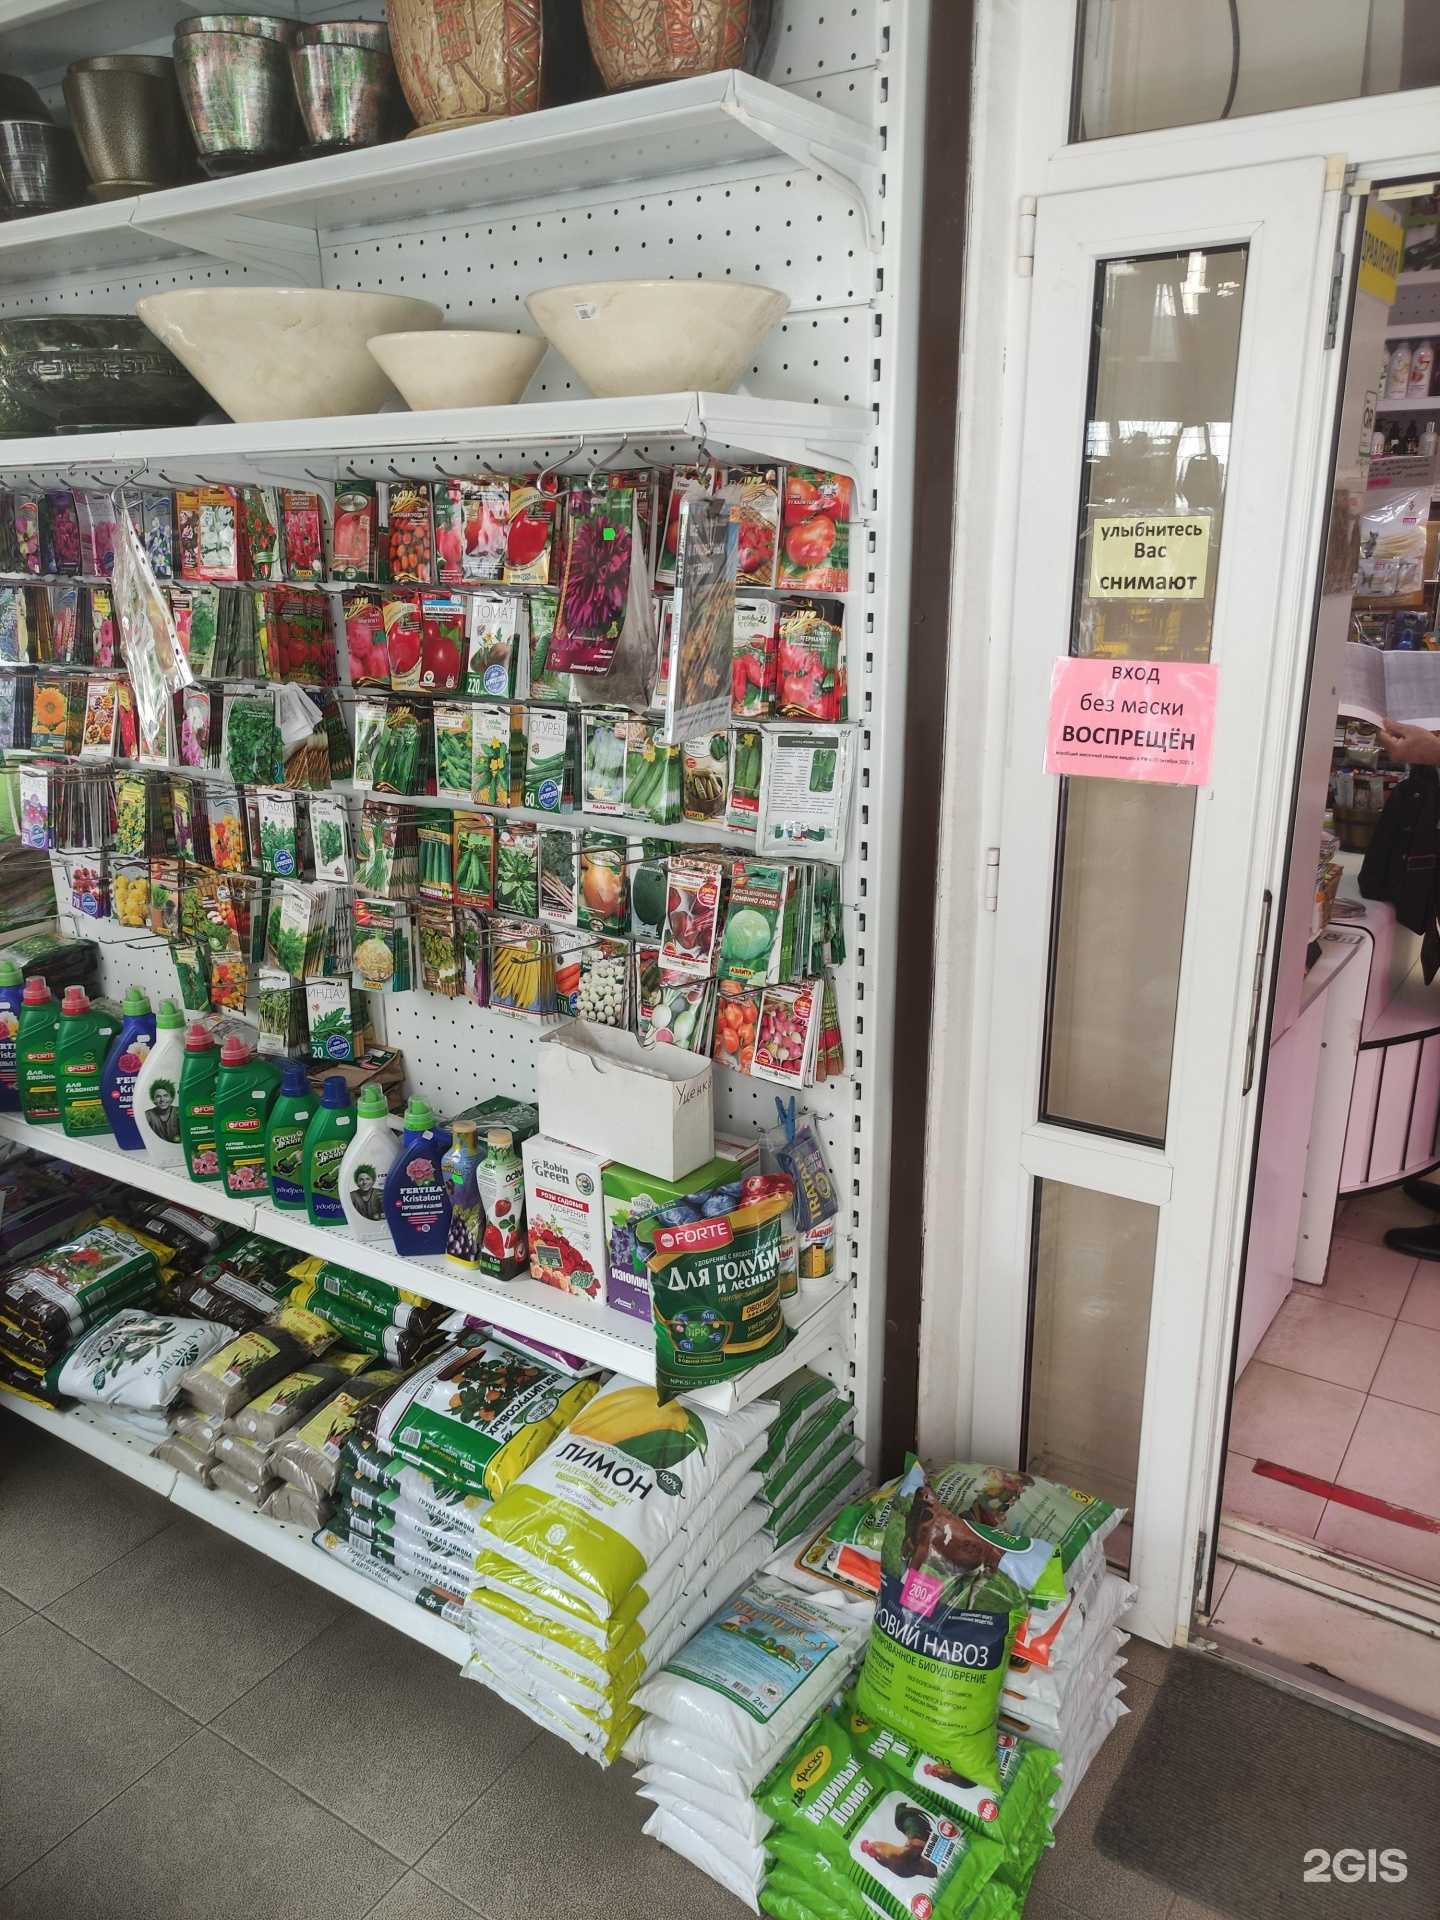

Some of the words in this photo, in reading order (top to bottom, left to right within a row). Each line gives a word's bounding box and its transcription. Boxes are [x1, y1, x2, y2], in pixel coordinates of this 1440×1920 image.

[1101, 522, 1202, 541] улыбнитесь
[1134, 542, 1167, 558] Вас
[1100, 574, 1198, 590] снимают
[1080, 693, 1115, 712] без
[1121, 701, 1184, 717] маски
[1062, 725, 1195, 753] ВОСПРЕЩЁН
[525, 792, 535, 807] 60
[312, 1046, 324, 1058] 20
[234, 1120, 259, 1128] FORTE
[534, 1165, 570, 1185] Green
[543, 1160, 569, 1175] Robin
[400, 1185, 443, 1195] FERTIKA
[402, 1193, 441, 1203] Kristalon
[674, 1222, 728, 1245] FORTE
[667, 1267, 710, 1291] Для
[718, 1283, 726, 1294] и
[731, 1269, 777, 1291] лесных
[688, 1327, 708, 1338] NPK
[487, 1383, 545, 1436] ЦИТРУСОВЫХ
[556, 1443, 653, 1500] ЛИМОН
[659, 1471, 680, 1490] 100%
[418, 1497, 437, 1514] ГРУНТ
[438, 1510, 450, 1522] ДЛЯ
[451, 1516, 475, 1535] ЛИМОНА
[414, 1525, 433, 1543] ГРУНТ
[434, 1535, 447, 1547] ДЛЯ
[447, 1542, 472, 1560] ЛИМОНА
[413, 1551, 433, 1567] ГРУНТ
[413, 1568, 433, 1584] ГРУНТ
[433, 1578, 447, 1589] ДЛЯ
[875, 1602, 920, 1649] ОВИЙ
[920, 1633, 988, 1667] НАВОЗ
[876, 1637, 917, 1667] РОВАННОЕ
[917, 1658, 987, 1685] БИОУДОБРЕНИЕ
[754, 1696, 769, 1710] 2кг
[796, 1750, 825, 1783] ФАСКО
